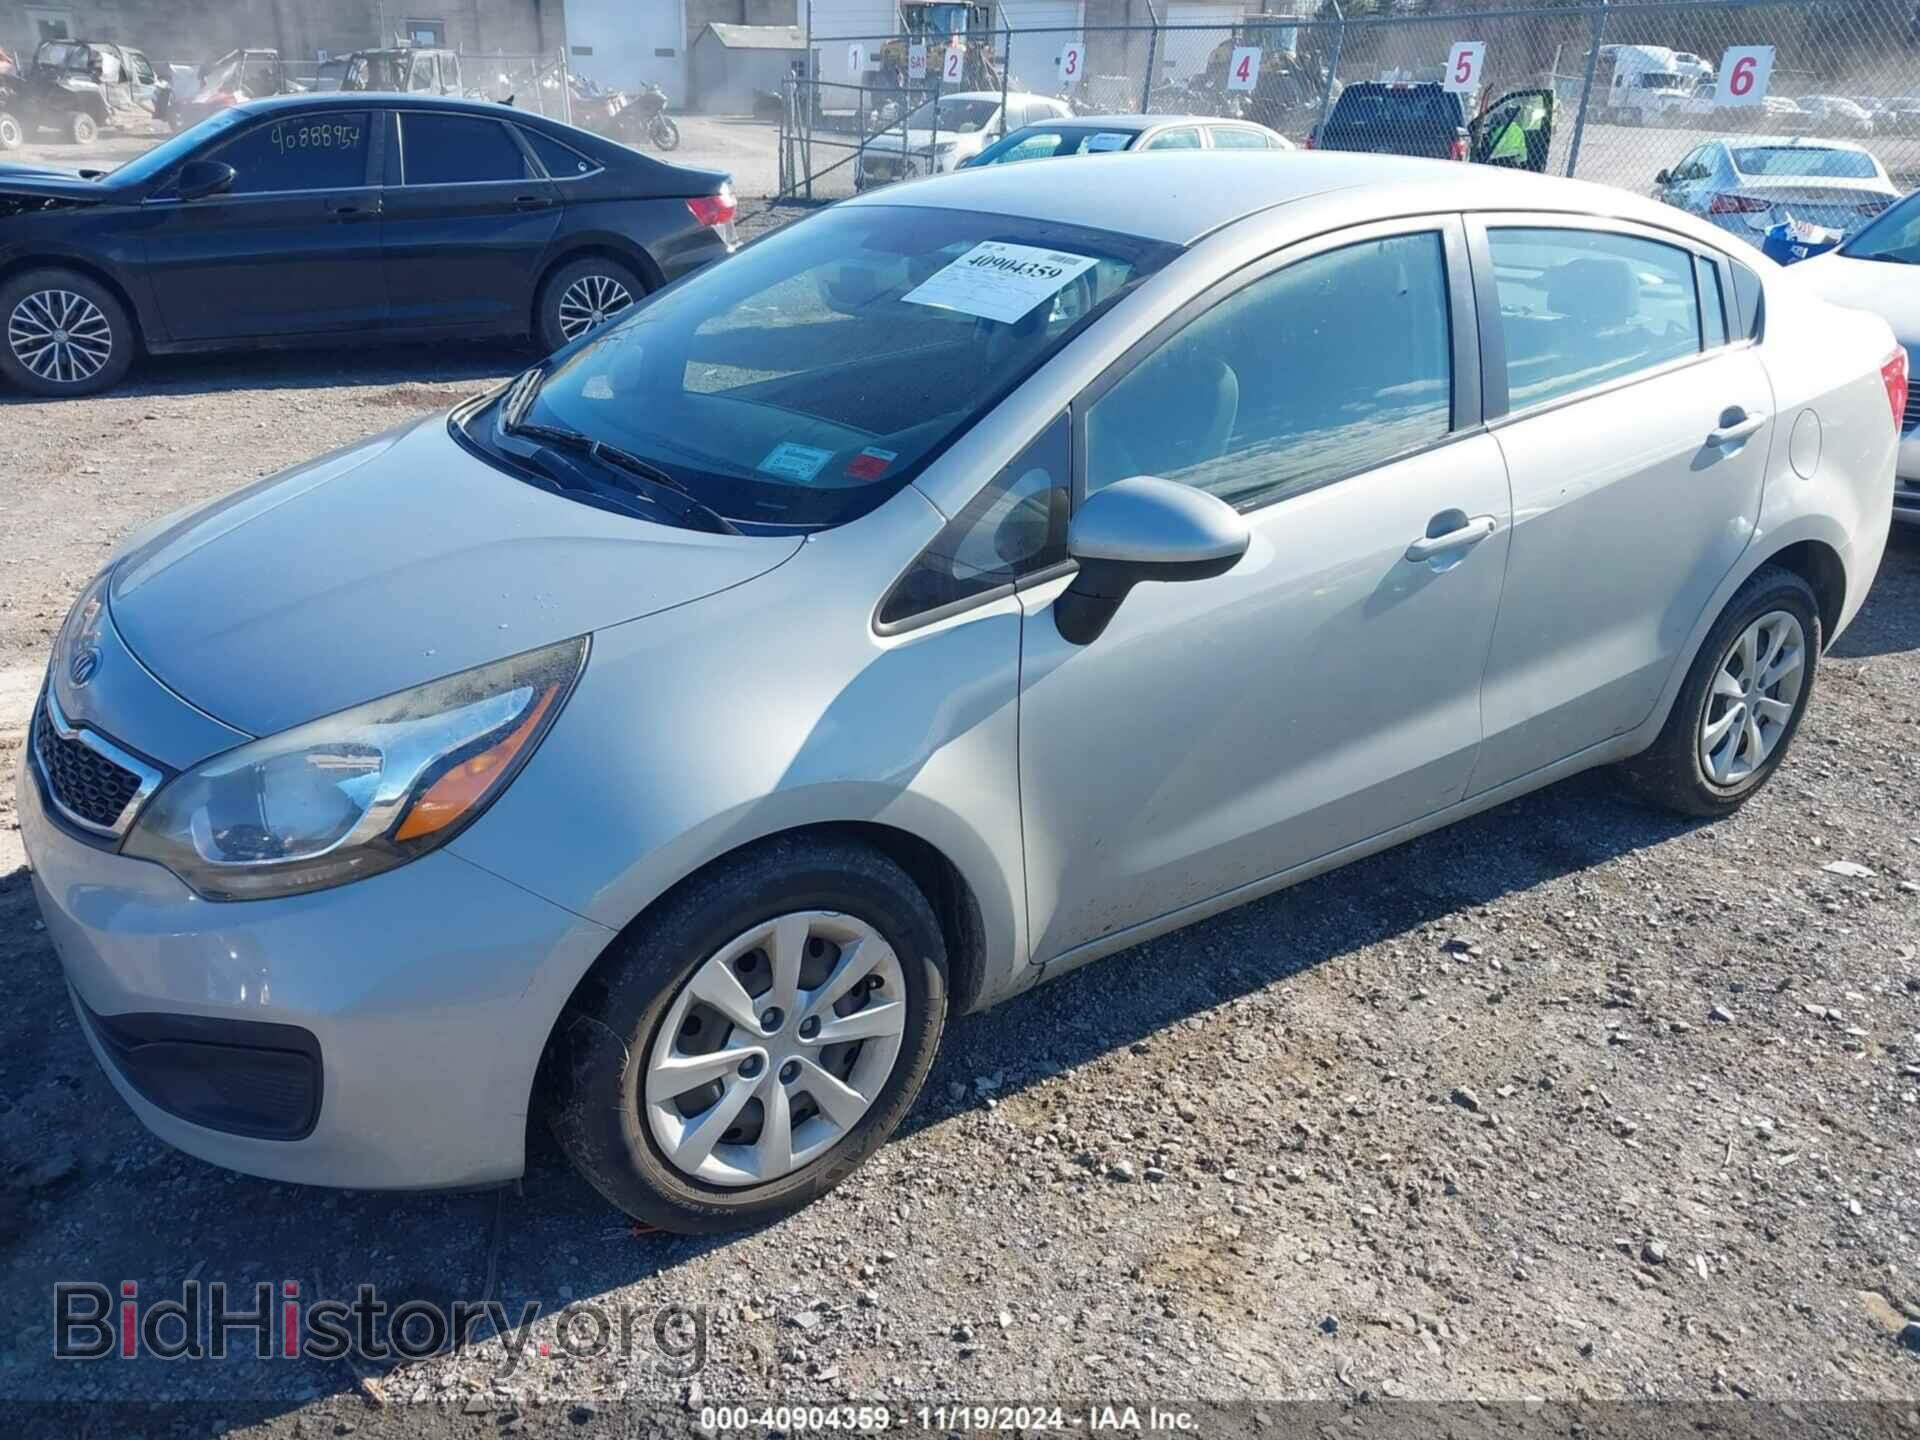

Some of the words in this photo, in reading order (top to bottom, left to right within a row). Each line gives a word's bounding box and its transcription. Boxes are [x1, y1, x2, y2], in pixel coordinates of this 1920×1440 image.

[853, 49, 859, 71] 1
[948, 54, 959, 77] 2
[1065, 50, 1078, 75] 3
[1236, 55, 1251, 82] 4
[1455, 51, 1474, 84] 5
[1730, 56, 1757, 96] 6
[967, 255, 1064, 280] 40904359
